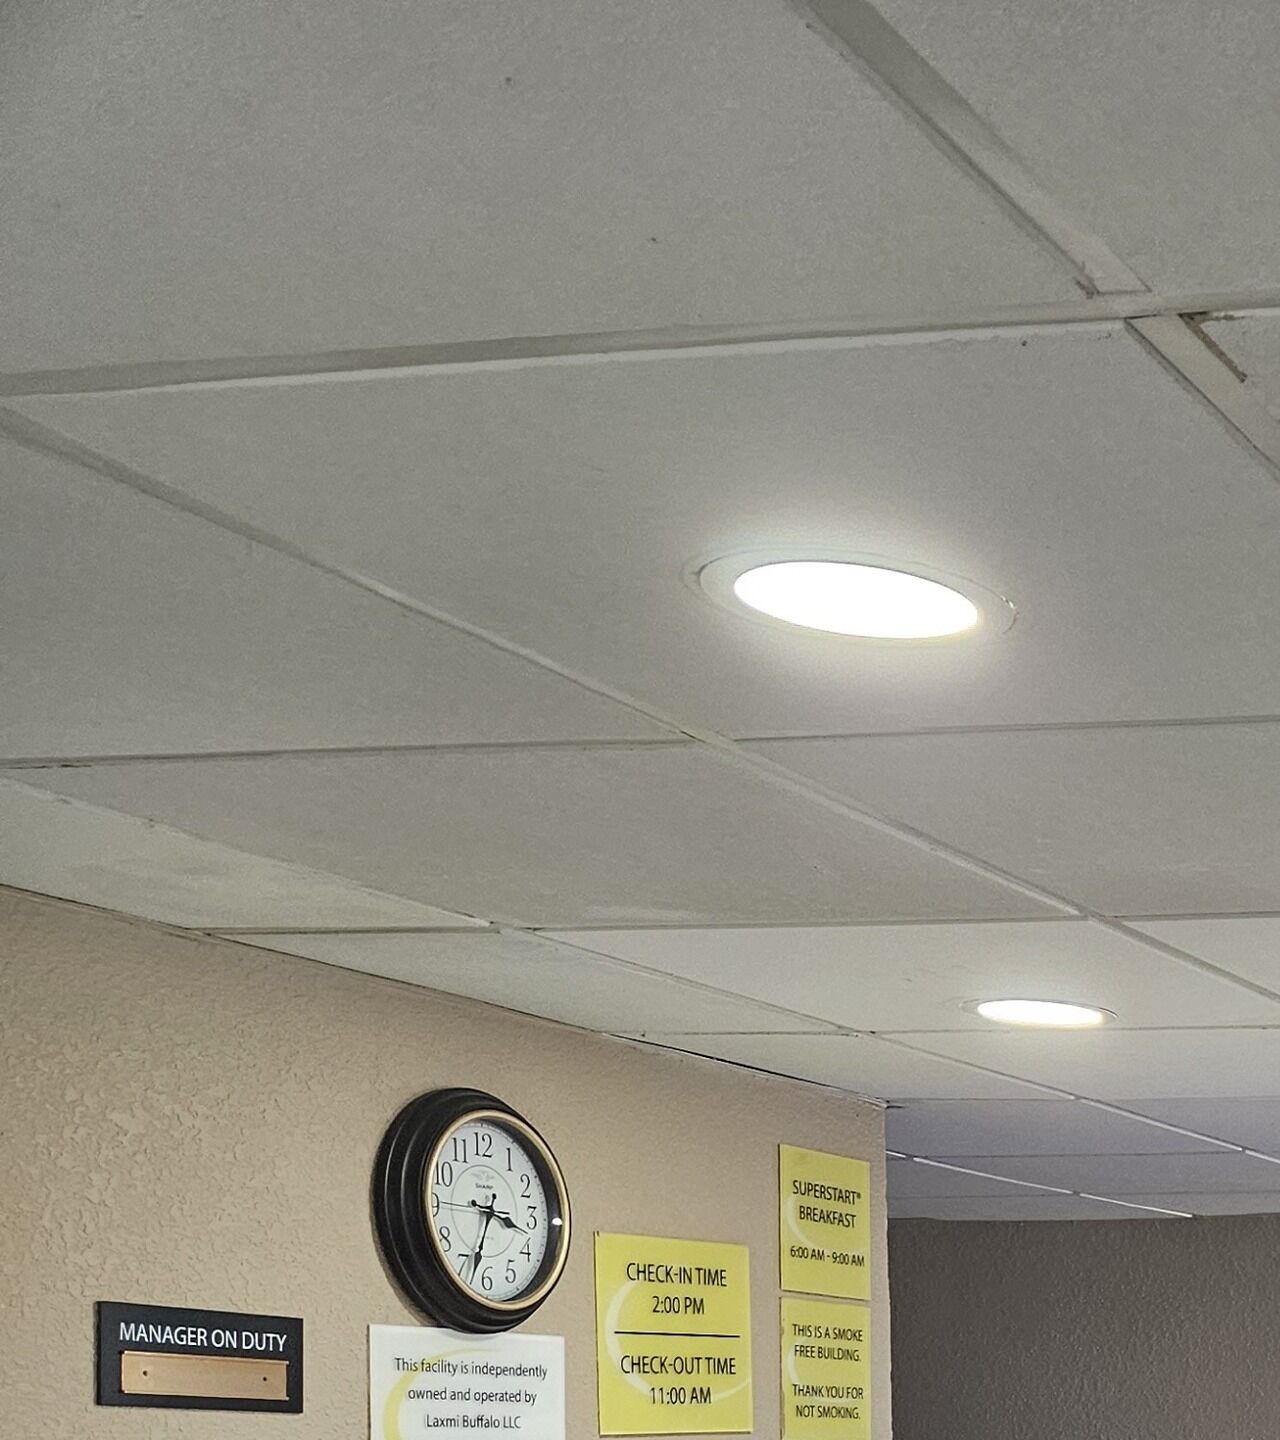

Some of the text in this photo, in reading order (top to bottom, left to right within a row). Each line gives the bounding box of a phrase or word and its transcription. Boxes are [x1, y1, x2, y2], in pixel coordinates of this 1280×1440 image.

[451, 1137, 468, 1163] 11
[473, 1131, 493, 1158] 12
[505, 1147, 513, 1171] 1
[435, 1159, 453, 1187] 10
[520, 1173, 531, 1198] 2
[526, 1205, 536, 1230] 3
[799, 1205, 856, 1228] BREAKFAST
[439, 1225, 451, 1252] 8
[519, 1236, 531, 1262] 4
[457, 1252, 469, 1276] 7
[790, 1245, 808, 1259] 6:00
[810, 1247, 825, 1261] AM
[831, 1251, 849, 1265] 9:00
[850, 1254, 864, 1266] AM
[481, 1266, 493, 1290] 6
[505, 1258, 516, 1283] 5
[626, 1262, 727, 1287] CHECK-IN TIME
[652, 1295, 704, 1314] 2:00 PM
[118, 1321, 287, 1352] MANAGER ON DUTY
[791, 1323, 862, 1342] THIS IS A SMOKE
[620, 1354, 736, 1374] CHECK-OUT TIME
[794, 1344, 861, 1361] FREE BUILDING.
[394, 1357, 547, 1381] This facility is independently
[408, 1387, 537, 1406] owned and operated by
[650, 1386, 711, 1404] 11:00 AM
[792, 1383, 863, 1399] THANK YOU FOR
[425, 1414, 521, 1429] Laxmi Buffalo LLC
[795, 1405, 860, 1419] NOT SMOKING.
